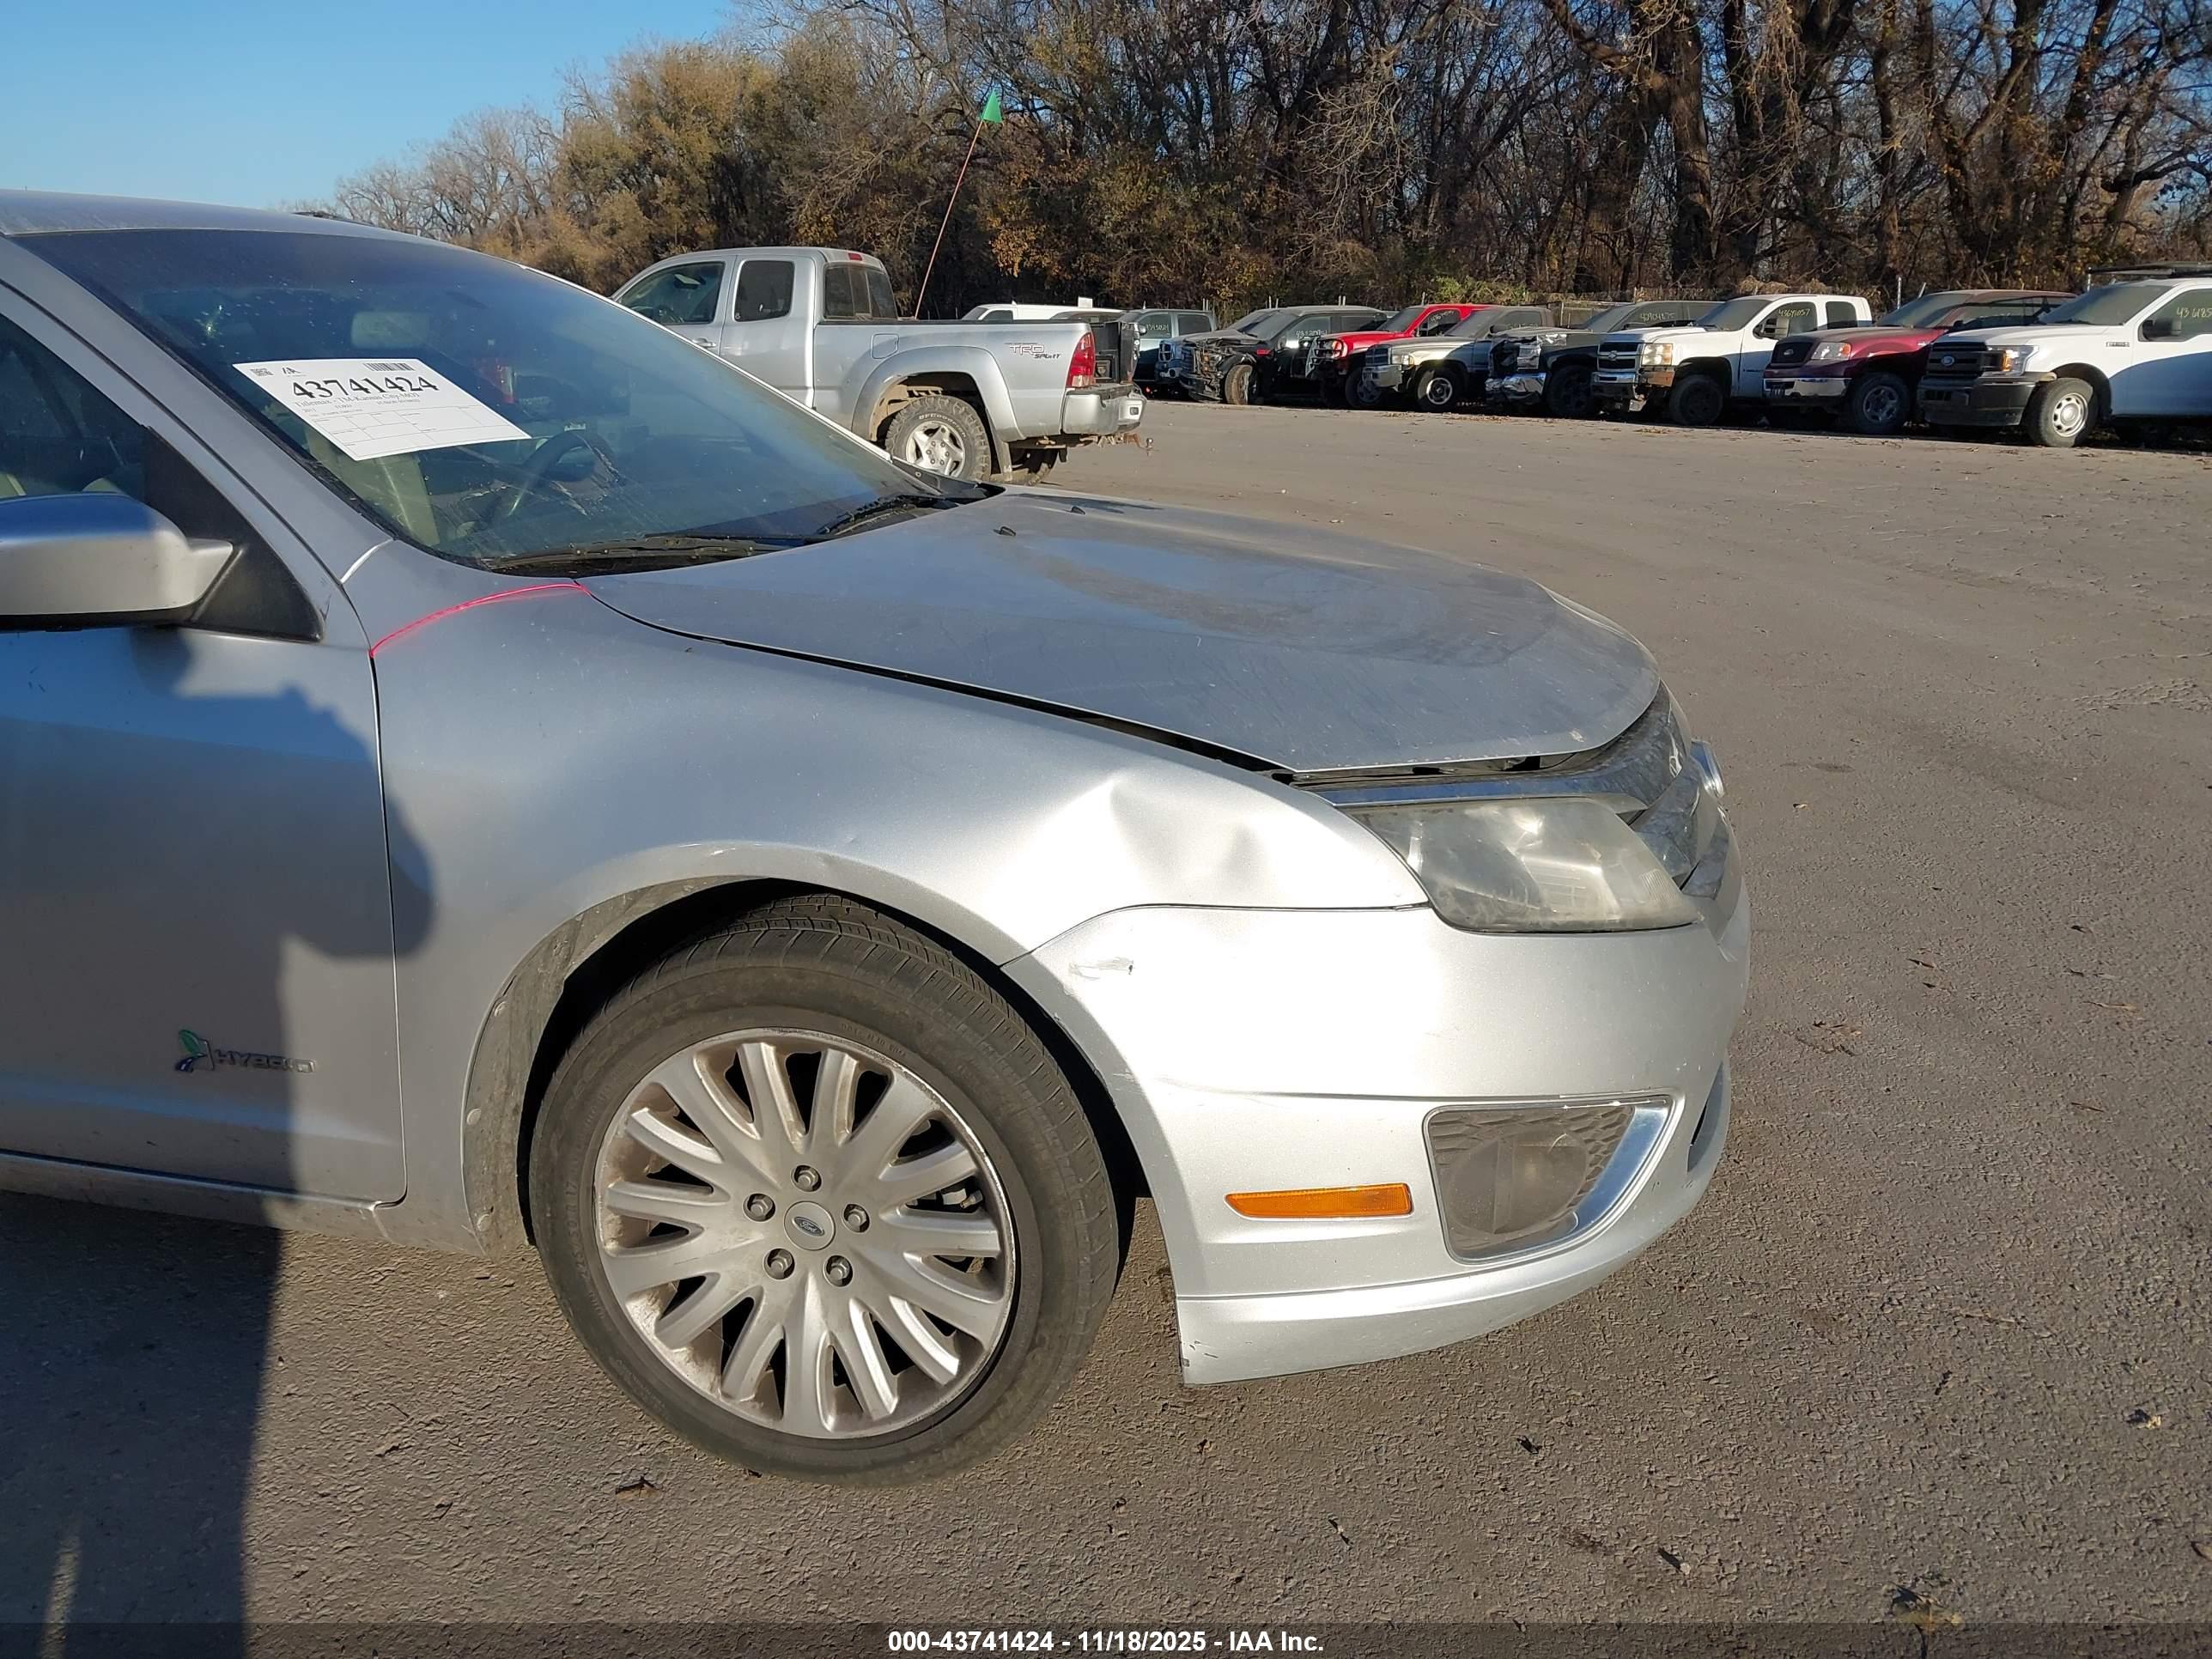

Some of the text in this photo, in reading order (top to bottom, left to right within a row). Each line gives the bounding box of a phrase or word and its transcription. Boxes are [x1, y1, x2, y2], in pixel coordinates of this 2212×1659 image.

[1009, 345, 1044, 356] TRD
[293, 376, 440, 398] 43741424
[215, 1049, 315, 1073] HYBRID
